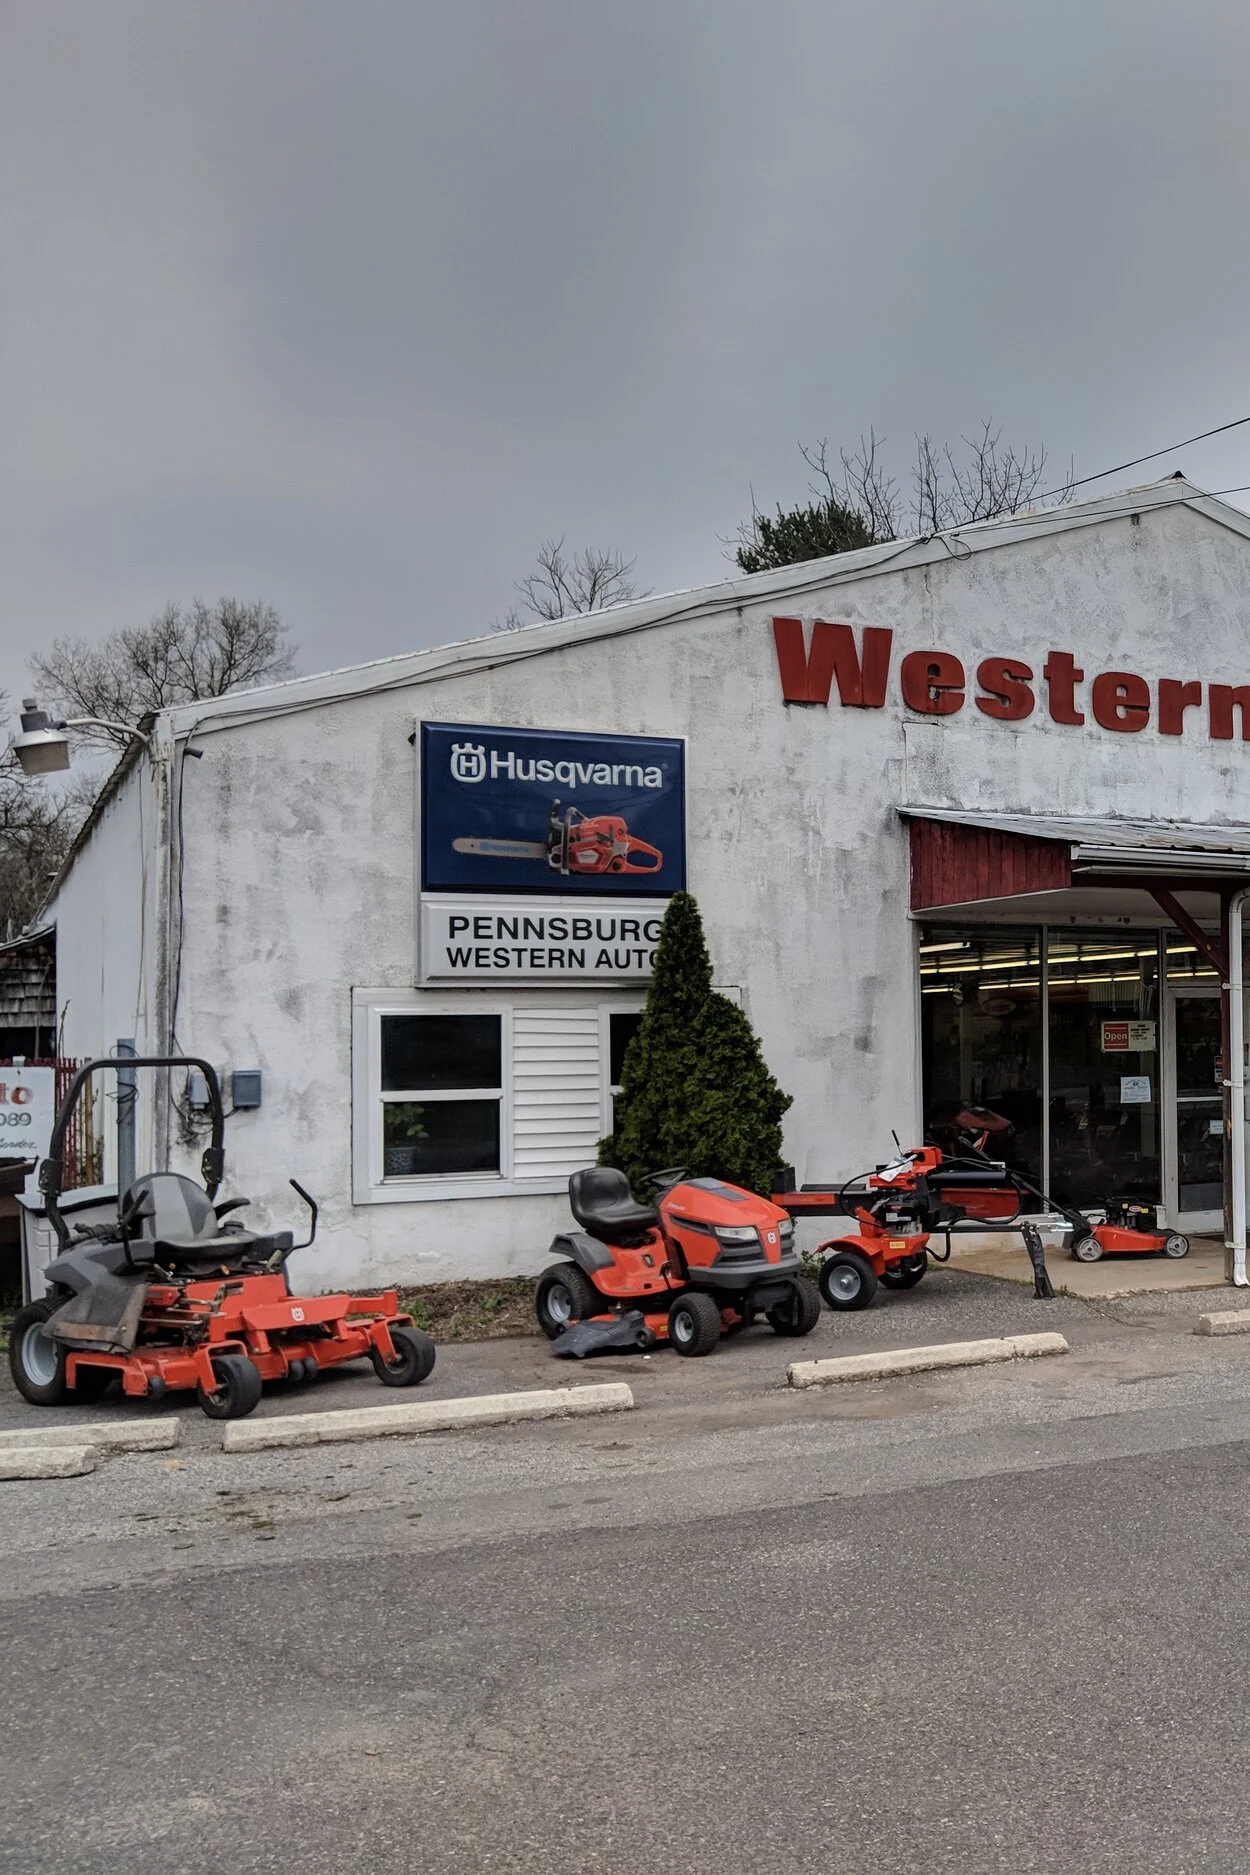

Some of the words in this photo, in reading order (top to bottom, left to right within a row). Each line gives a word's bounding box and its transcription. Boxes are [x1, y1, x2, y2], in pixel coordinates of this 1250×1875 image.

[490, 750, 662, 789] Husqvarna
[446, 947, 586, 968] WESTERN
[1104, 1032, 1128, 1041] Open
